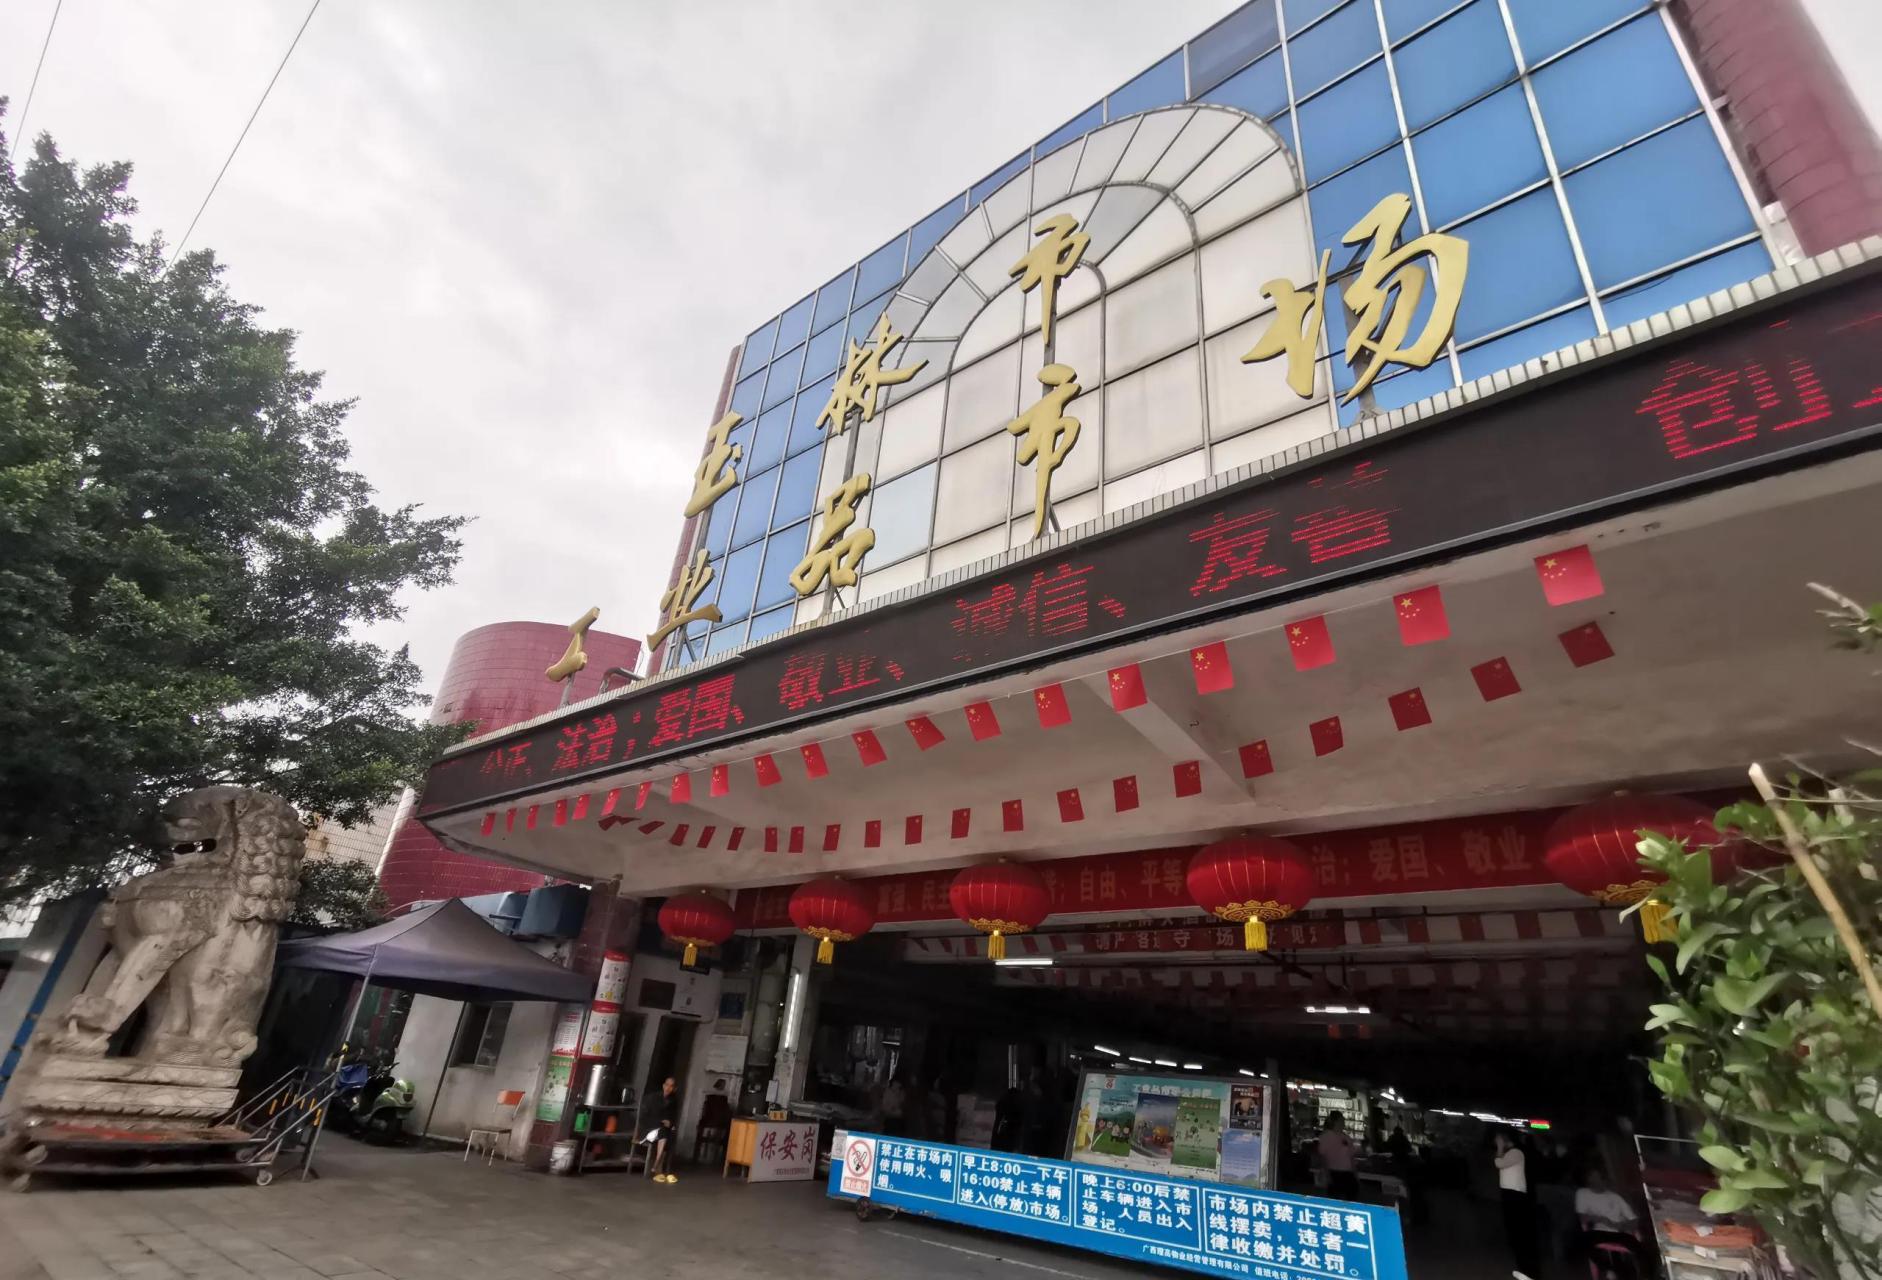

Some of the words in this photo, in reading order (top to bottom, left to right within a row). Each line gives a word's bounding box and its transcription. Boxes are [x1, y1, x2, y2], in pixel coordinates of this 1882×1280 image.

[761, 1126, 816, 1164] 保安岗
[880, 1143, 953, 1166] 禁止在市场内
[1082, 1187, 1192, 1216] 止车辆进入市
[1208, 1194, 1367, 1235] 市场内禁止超黄
